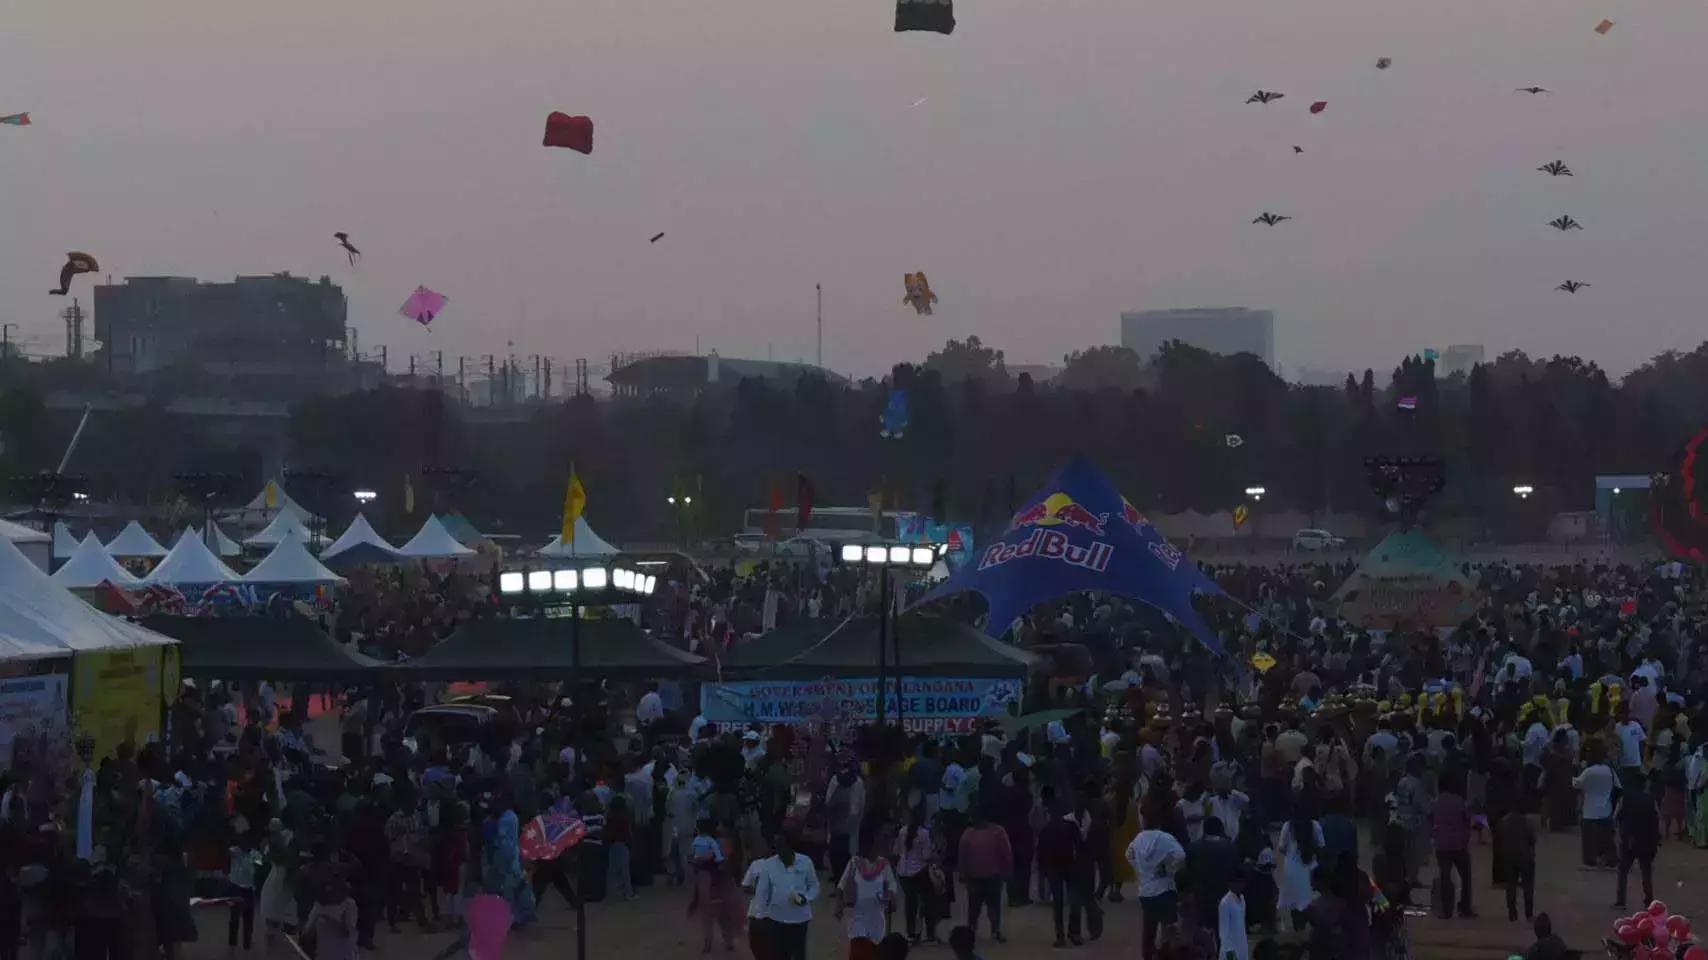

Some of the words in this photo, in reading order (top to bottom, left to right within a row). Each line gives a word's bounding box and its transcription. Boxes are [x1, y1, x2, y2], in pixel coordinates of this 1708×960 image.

[976, 528, 1043, 571] Red
[1037, 529, 1114, 572] Bull
[925, 696, 981, 713] BOARD
[903, 717, 963, 733] SUPPLY
